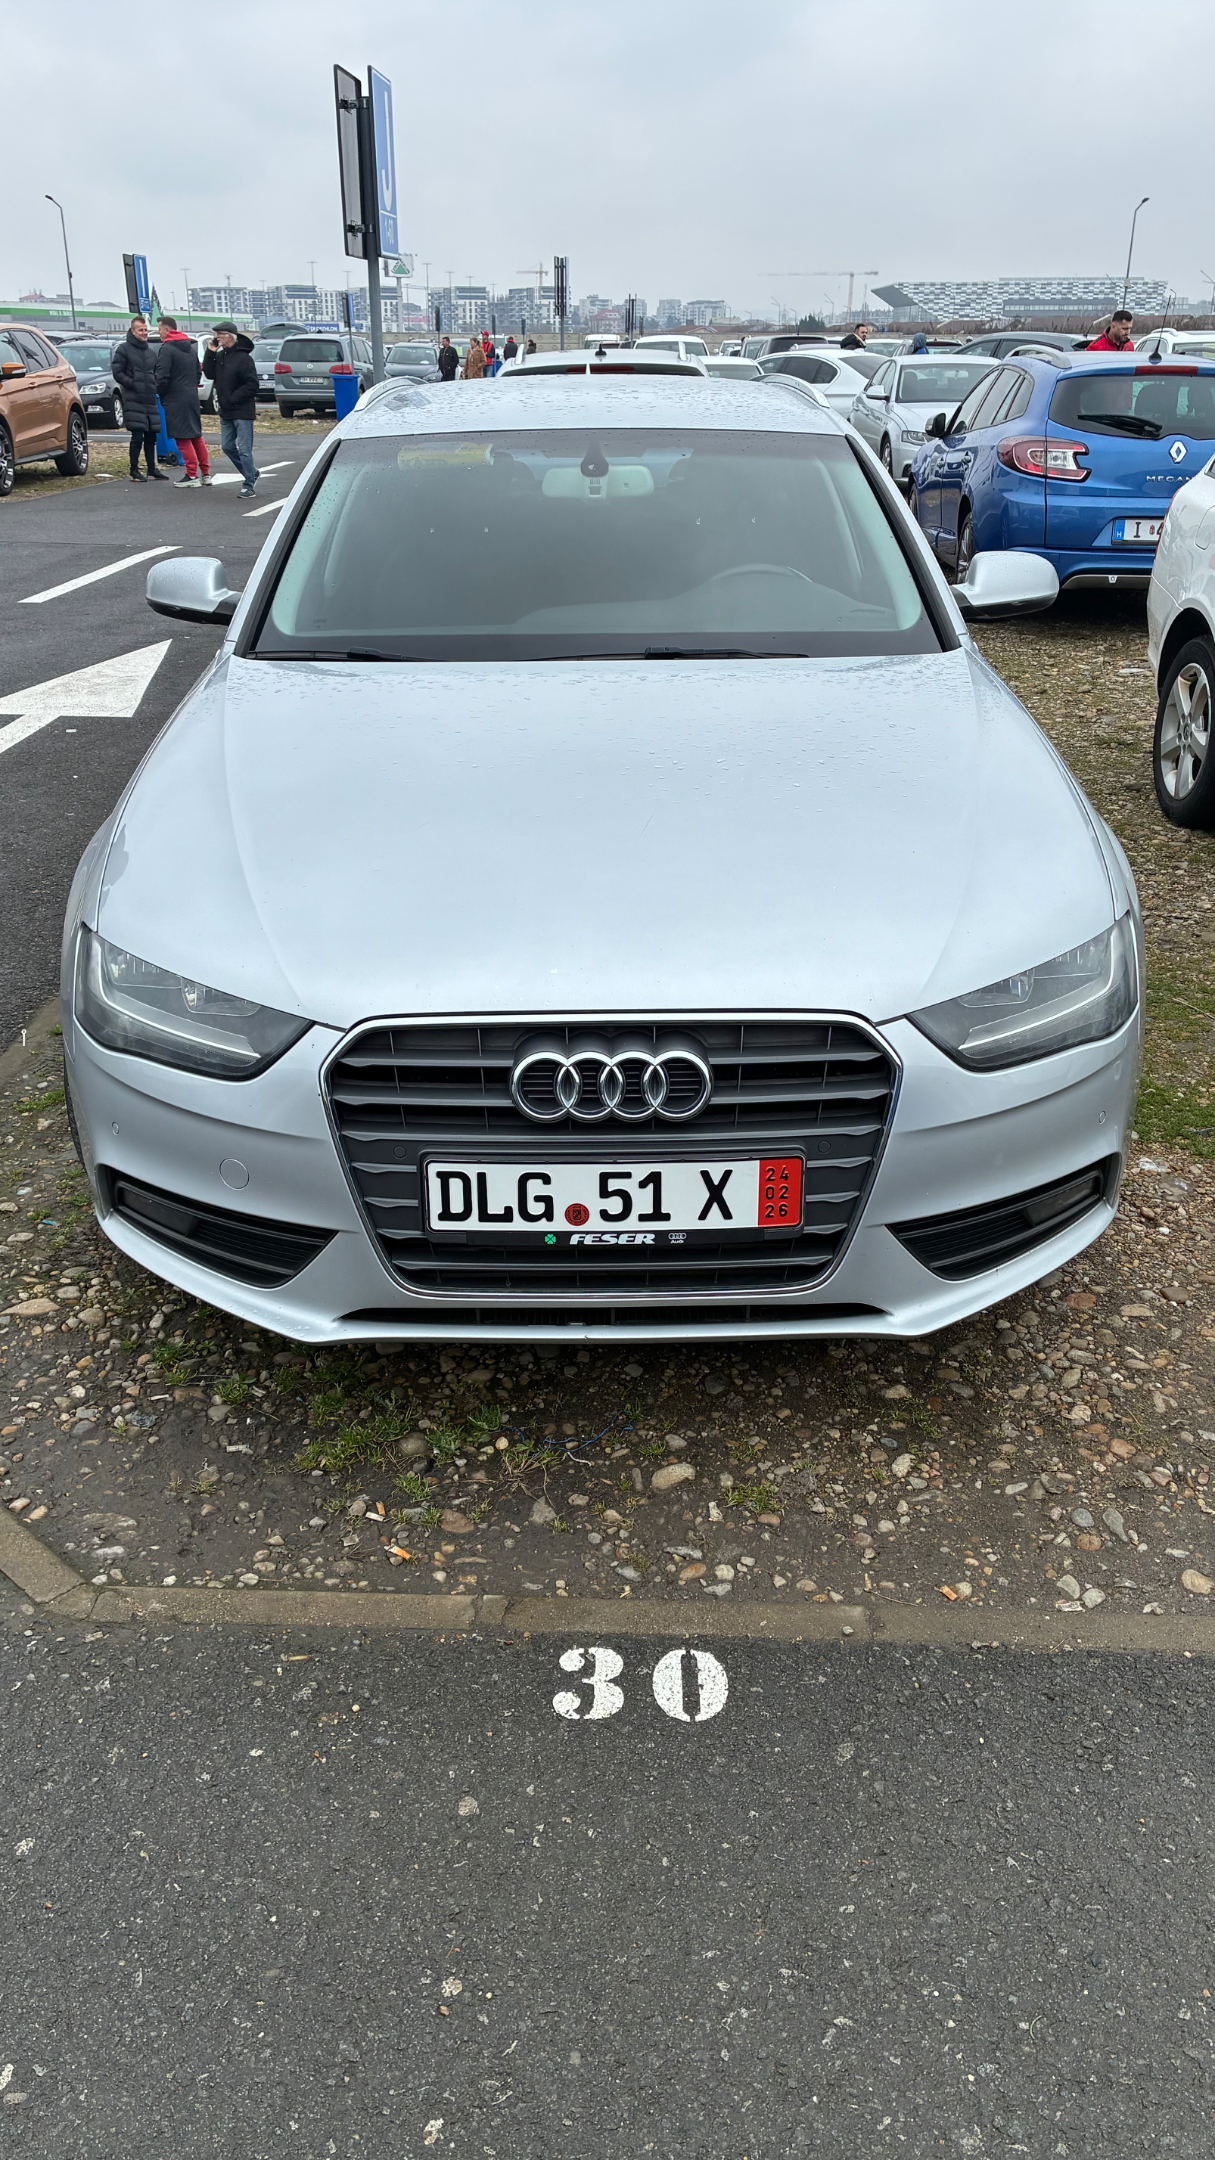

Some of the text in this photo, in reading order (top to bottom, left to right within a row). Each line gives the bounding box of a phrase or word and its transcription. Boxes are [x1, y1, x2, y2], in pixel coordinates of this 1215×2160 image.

[382, 91, 393, 212] J
[765, 1165, 789, 1182] 24
[436, 1170, 554, 1223] DLG
[598, 1171, 672, 1222] 51
[697, 1169, 734, 1221] X
[765, 1184, 789, 1200] 02
[764, 1202, 788, 1218] 26
[569, 1233, 656, 1245] FESER
[553, 1646, 729, 1722] 30
